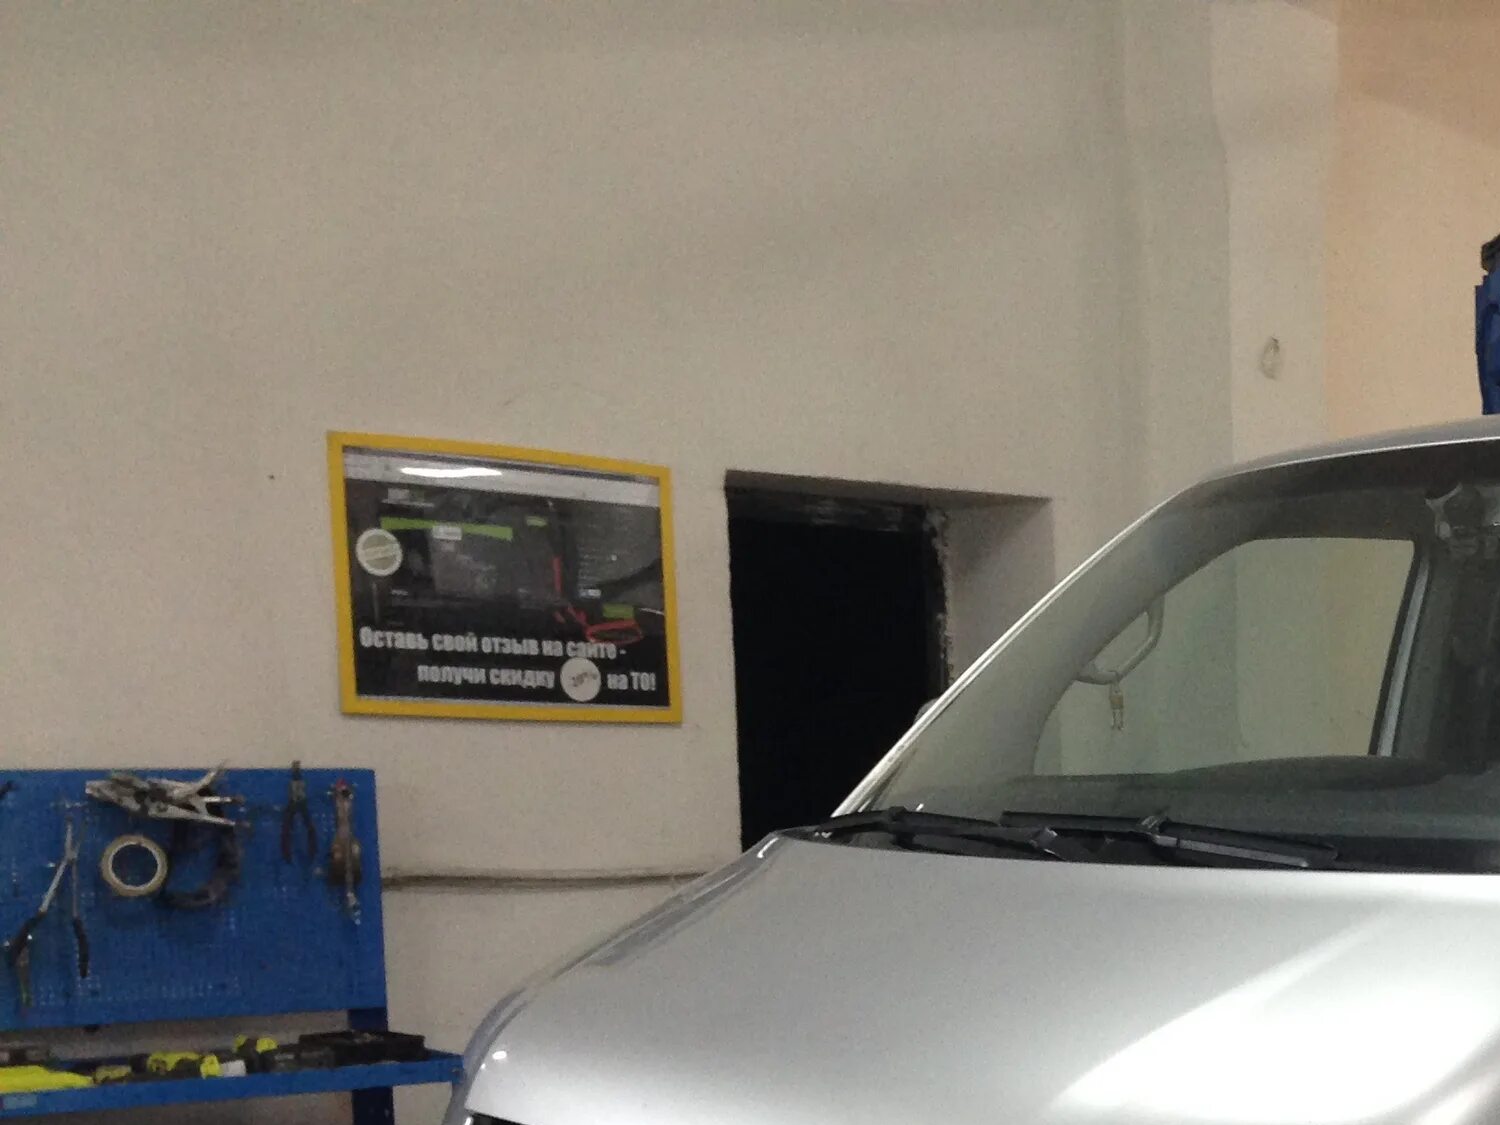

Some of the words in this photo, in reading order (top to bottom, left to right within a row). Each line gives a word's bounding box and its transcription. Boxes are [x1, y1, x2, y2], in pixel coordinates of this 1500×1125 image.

[359, 626, 429, 650] Оставь
[432, 632, 478, 652] свой
[481, 636, 539, 656] отзыв
[542, 640, 563, 657] на
[417, 665, 487, 685] получи
[489, 668, 555, 689] скидку
[606, 673, 628, 690] на
[630, 671, 657, 691] ТО!
